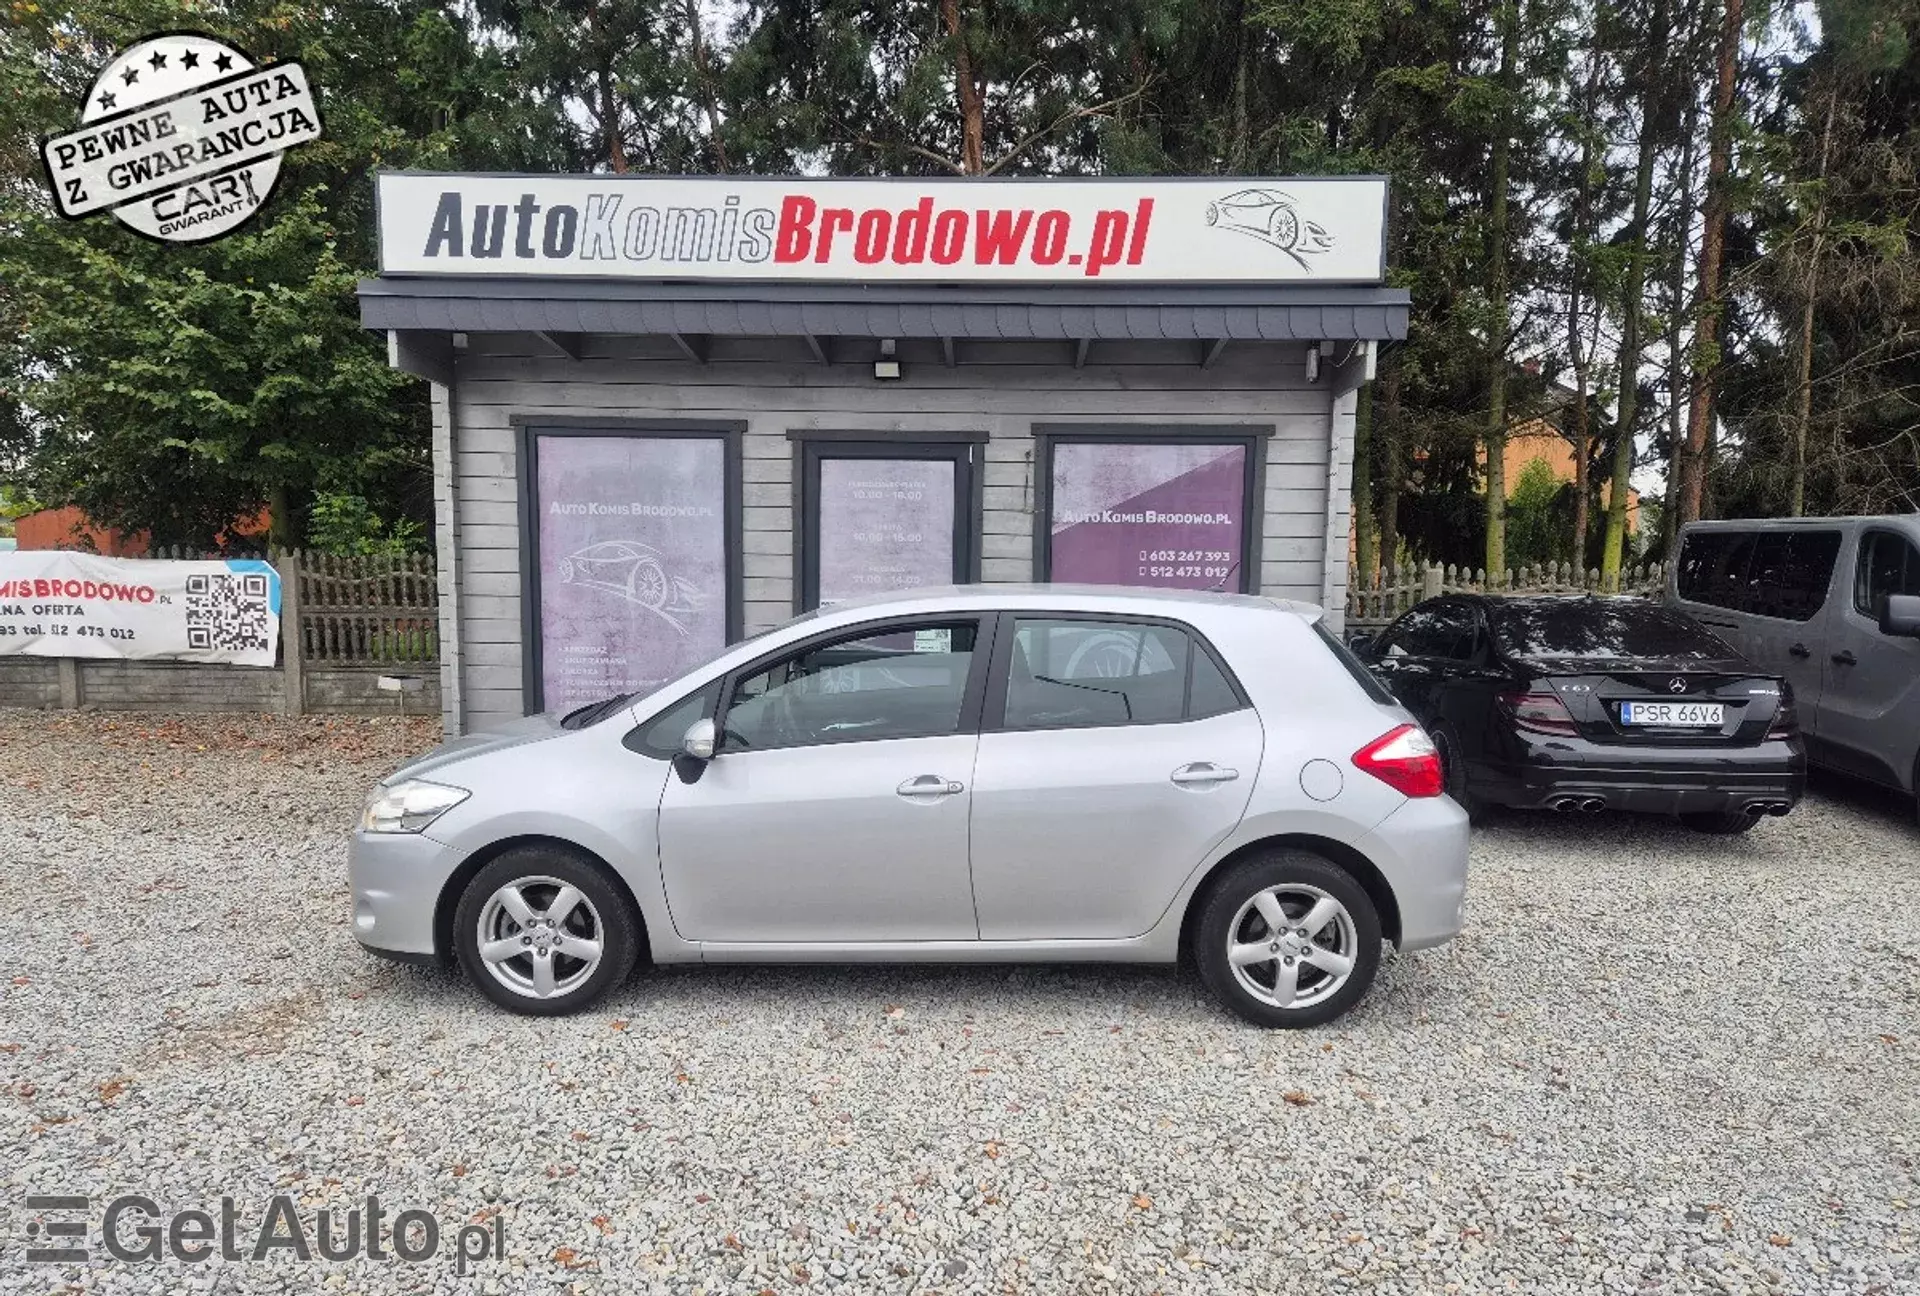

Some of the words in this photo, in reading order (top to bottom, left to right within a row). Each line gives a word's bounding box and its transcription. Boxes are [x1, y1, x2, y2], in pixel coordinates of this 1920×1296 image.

[424, 191, 1155, 276] AutoKomisBrodowo.pl
[1149, 551, 1176, 562] 603
[1178, 551, 1202, 562] 267
[1204, 551, 1230, 562] 393
[1150, 566, 1175, 578] 512
[1176, 567, 1202, 578] 473
[1204, 567, 1229, 578] 012
[32, 604, 85, 616] OFERTA
[23, 624, 46, 636] tel.
[77, 625, 105, 638] 473
[110, 627, 136, 640] 012
[1633, 705, 1672, 721] PSR
[1678, 705, 1720, 722] 66V6
